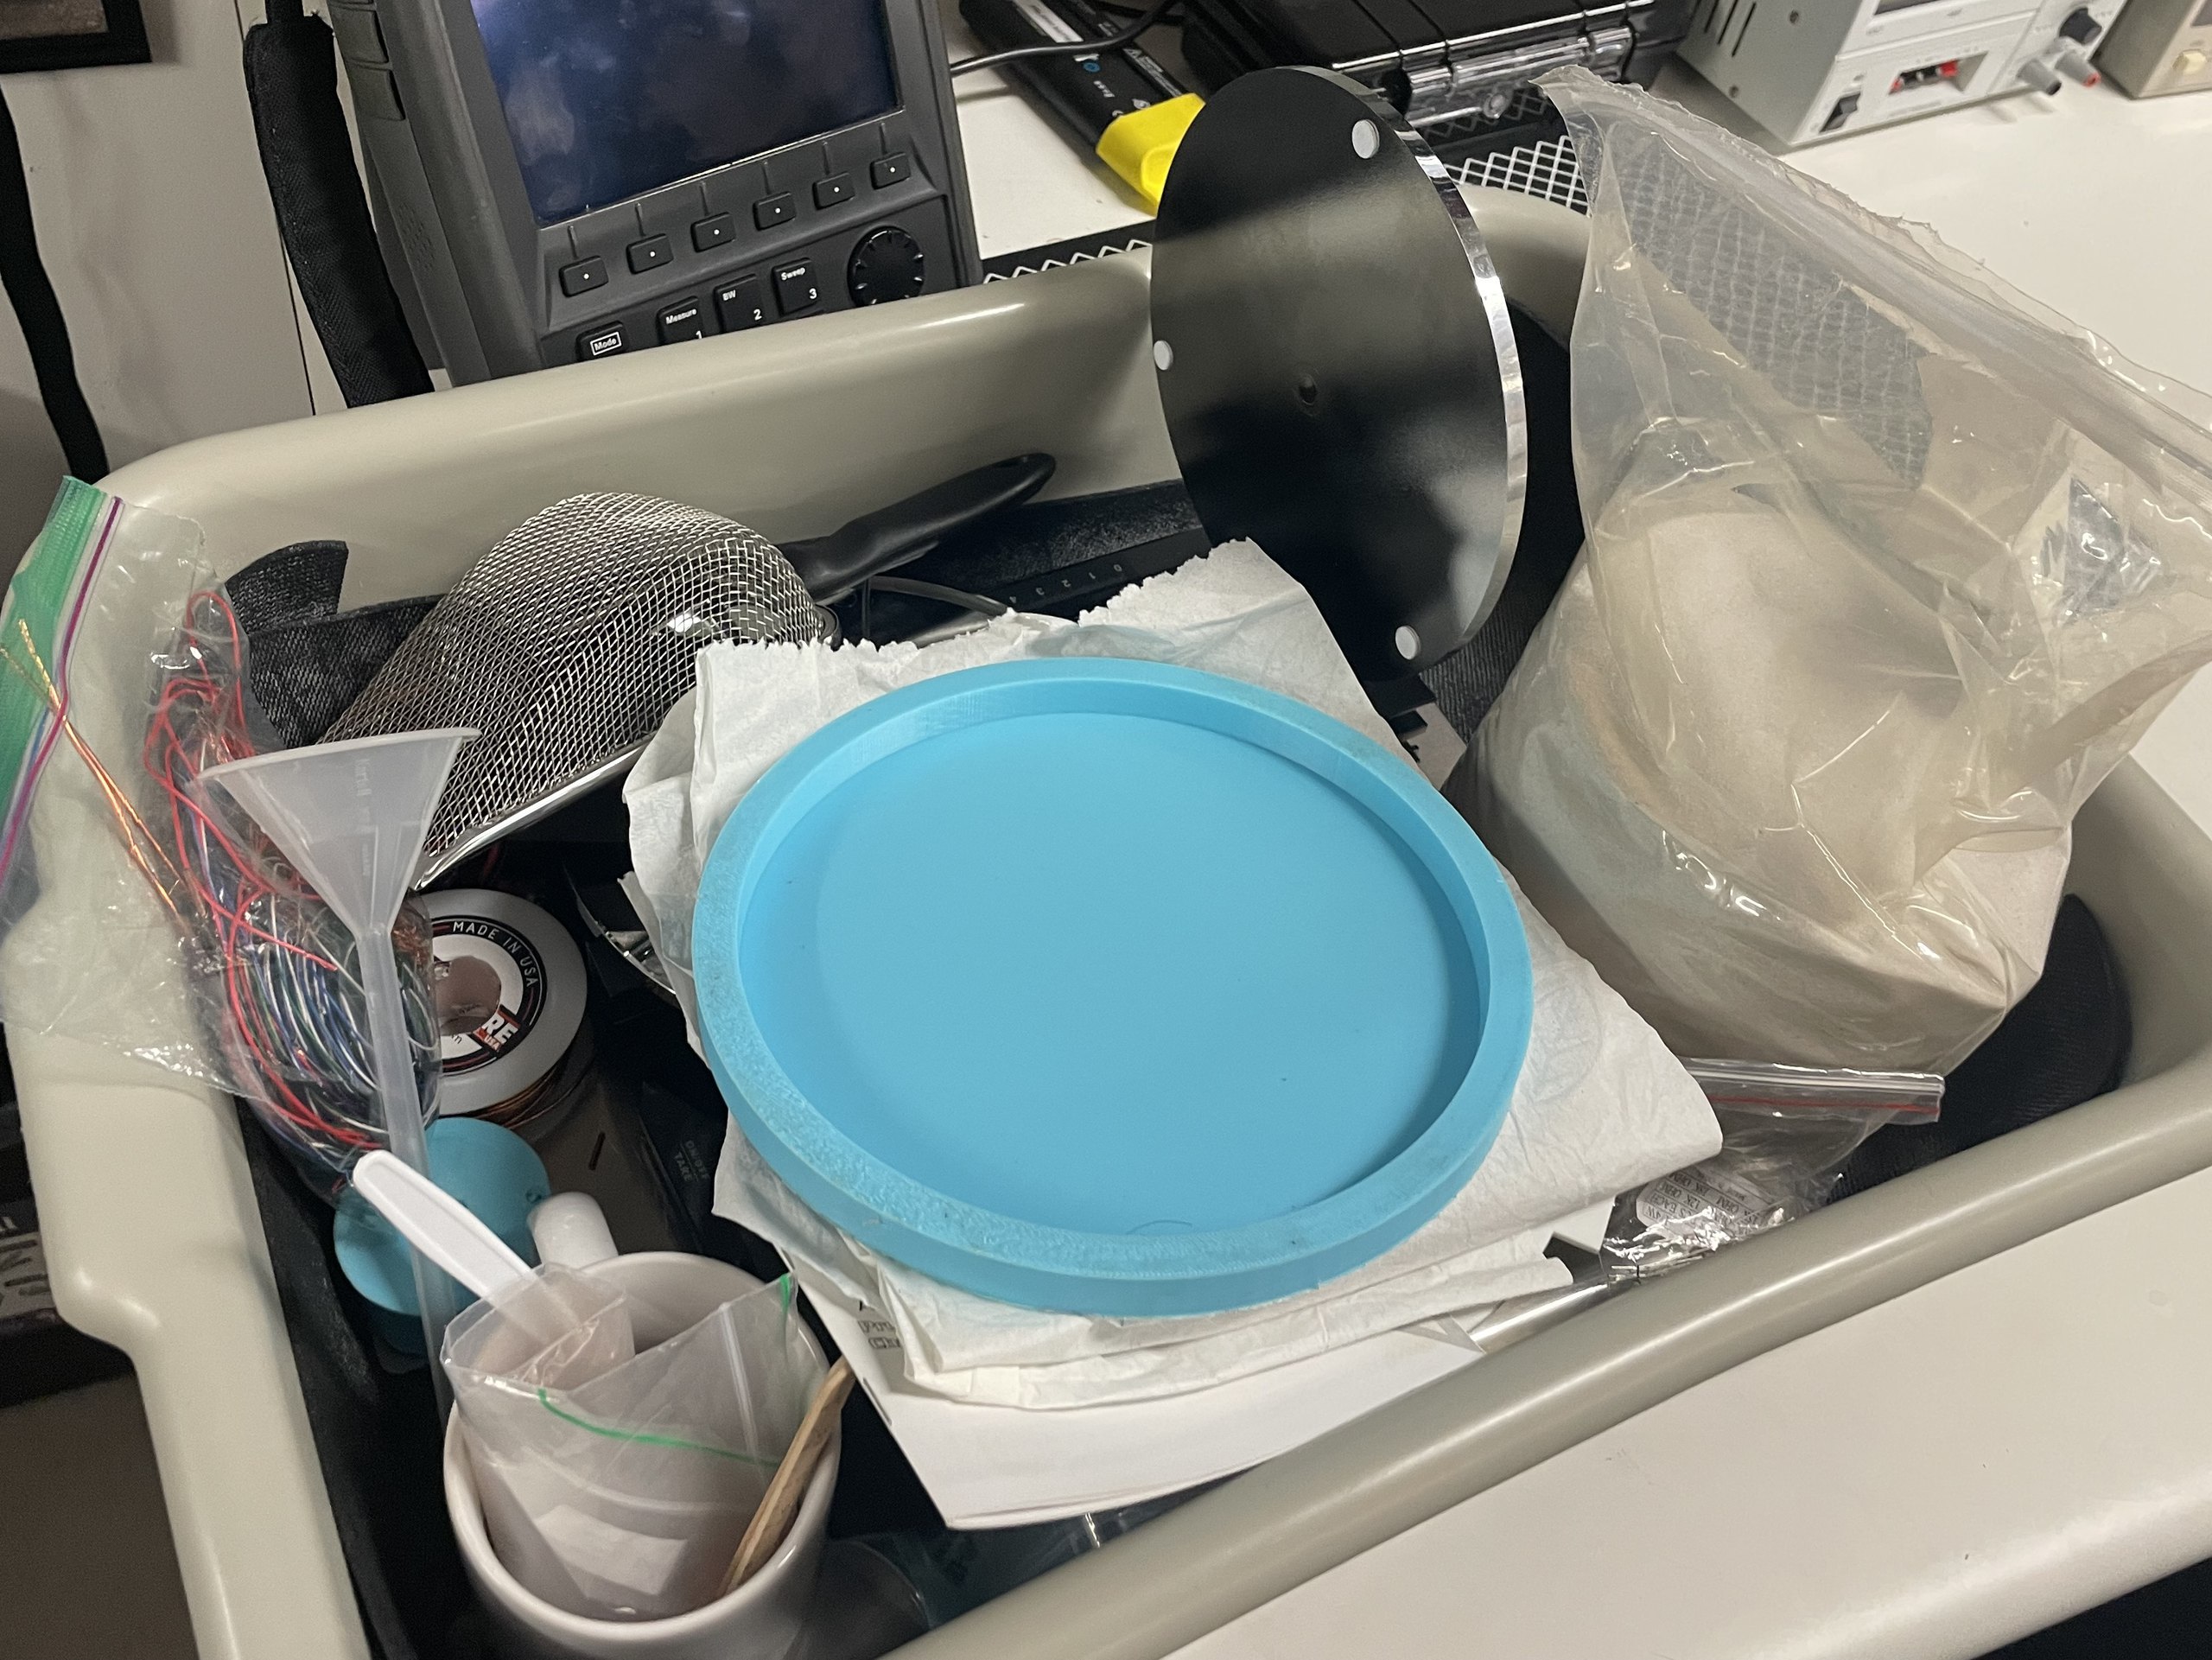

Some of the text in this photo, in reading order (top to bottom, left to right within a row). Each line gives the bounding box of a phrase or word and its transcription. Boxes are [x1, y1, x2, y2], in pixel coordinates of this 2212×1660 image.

[780, 267, 805, 281] Sweep
[722, 289, 736, 302] BW
[809, 288, 817, 300] 3
[665, 308, 697, 325] Measure
[753, 308, 762, 321] 2
[695, 330, 702, 340] 1
[594, 338, 617, 351] Mode
[1061, 578, 1071, 588] 2
[1035, 587, 1045, 596] 3
[453, 921, 538, 987] MADE IN USA
[1649, 1193, 1677, 1213] EACH
[1716, 1196, 1740, 1214] OHM
